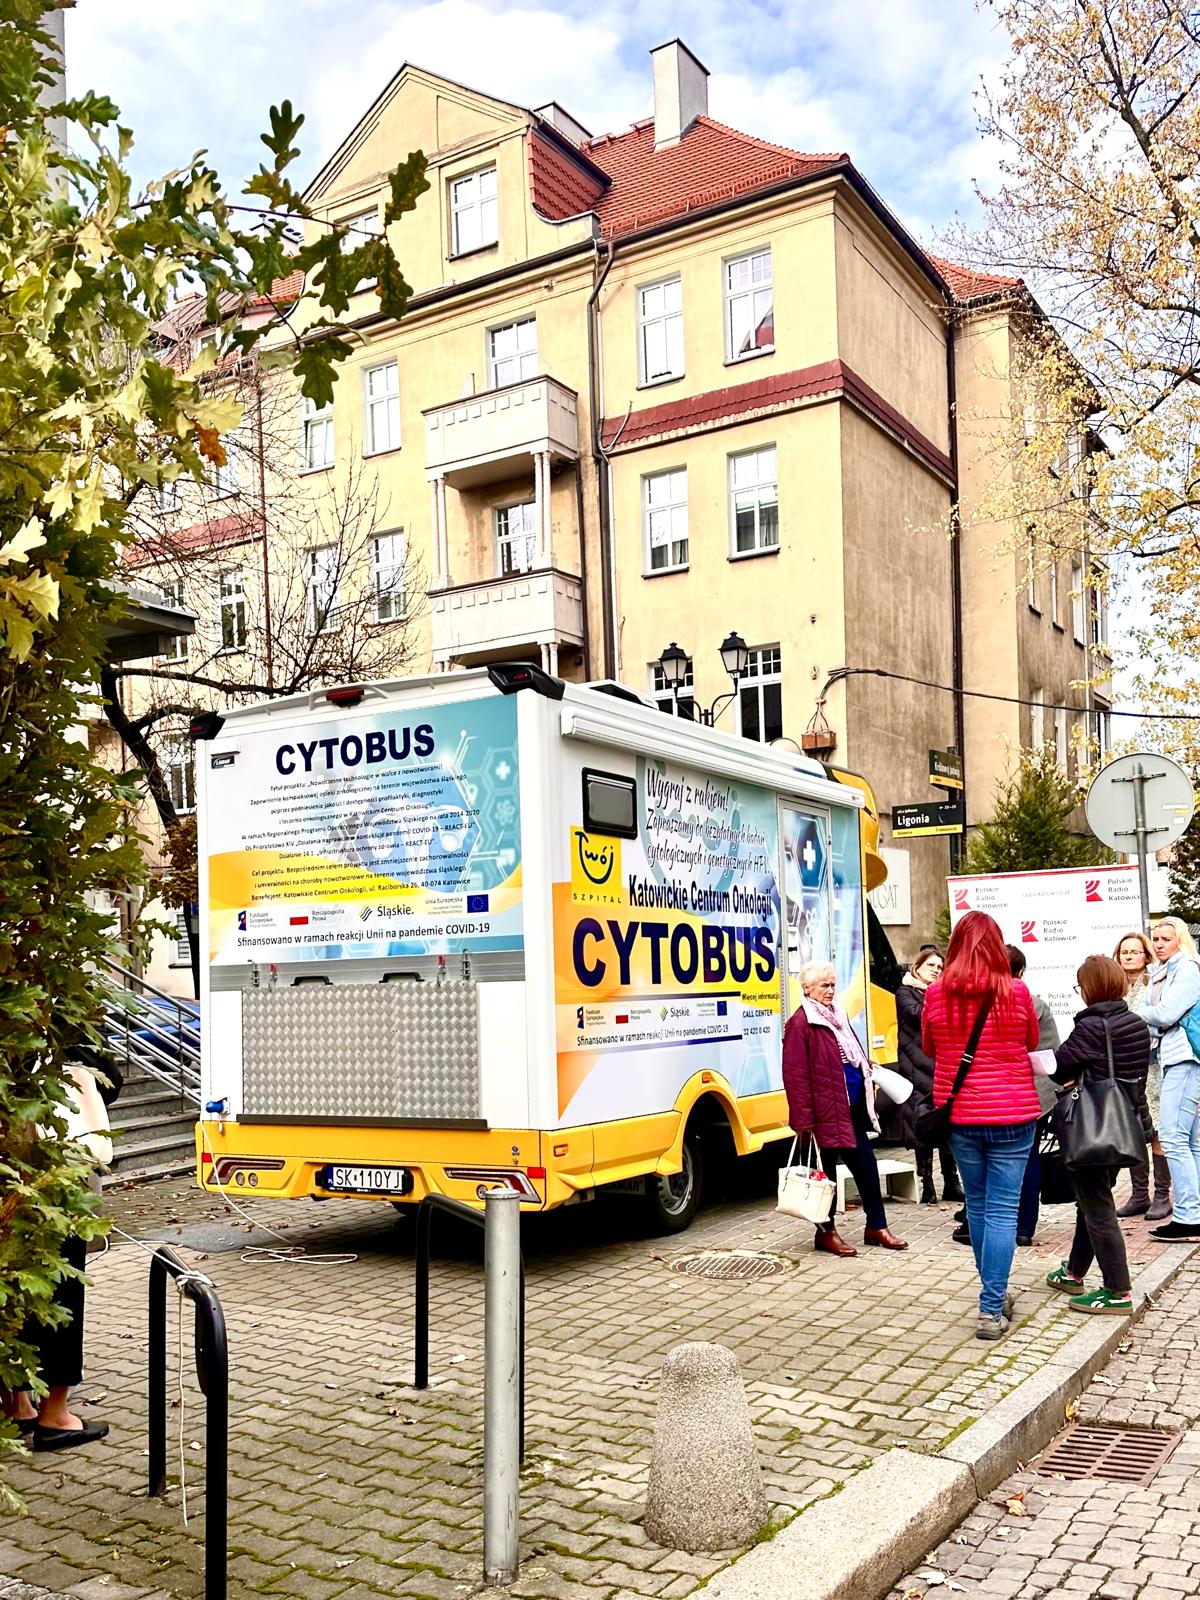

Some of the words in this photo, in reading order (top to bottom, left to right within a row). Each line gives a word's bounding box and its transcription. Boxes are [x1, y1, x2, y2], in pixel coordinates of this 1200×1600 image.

[276, 724, 436, 775] CYTOBUS
[646, 768, 684, 812] Wygraj
[686, 786, 692, 803] z
[694, 779, 730, 812] rakiem!
[646, 808, 694, 843] Zapraszamy
[897, 814, 930, 827] Ligonia
[574, 831, 614, 884] Twój
[646, 839, 702, 872] cytologicznych
[708, 852, 752, 878] genetycznych
[573, 892, 622, 904] SZPITAL
[629, 874, 688, 911] Katowickie
[691, 881, 730, 913] Centrum
[732, 885, 772, 922] Onkologii
[377, 902, 414, 919] Śląskie.
[237, 934, 292, 946] Sfinansowano
[303, 931, 334, 942] ramach
[336, 930, 363, 943] reakcji
[366, 928, 383, 939] Unii
[398, 925, 443, 939] pandemie
[445, 922, 489, 934] COVID-19
[1044, 934, 1078, 942] Katowice
[572, 918, 776, 988] CYTOBUS
[742, 993, 757, 1002] Więcej
[743, 1010, 754, 1018] CALL
[755, 1009, 773, 1017] CENTER
[577, 1036, 618, 1046] Sfinansowano
[626, 1032, 646, 1041] ramach
[647, 1030, 663, 1040] reakcji
[664, 1029, 675, 1038] Unii
[683, 1027, 706, 1037] pandemie
[707, 1024, 728, 1033] COVID-19
[336, 1169, 352, 1186] SK
[359, 1170, 400, 1188] 110YJ
